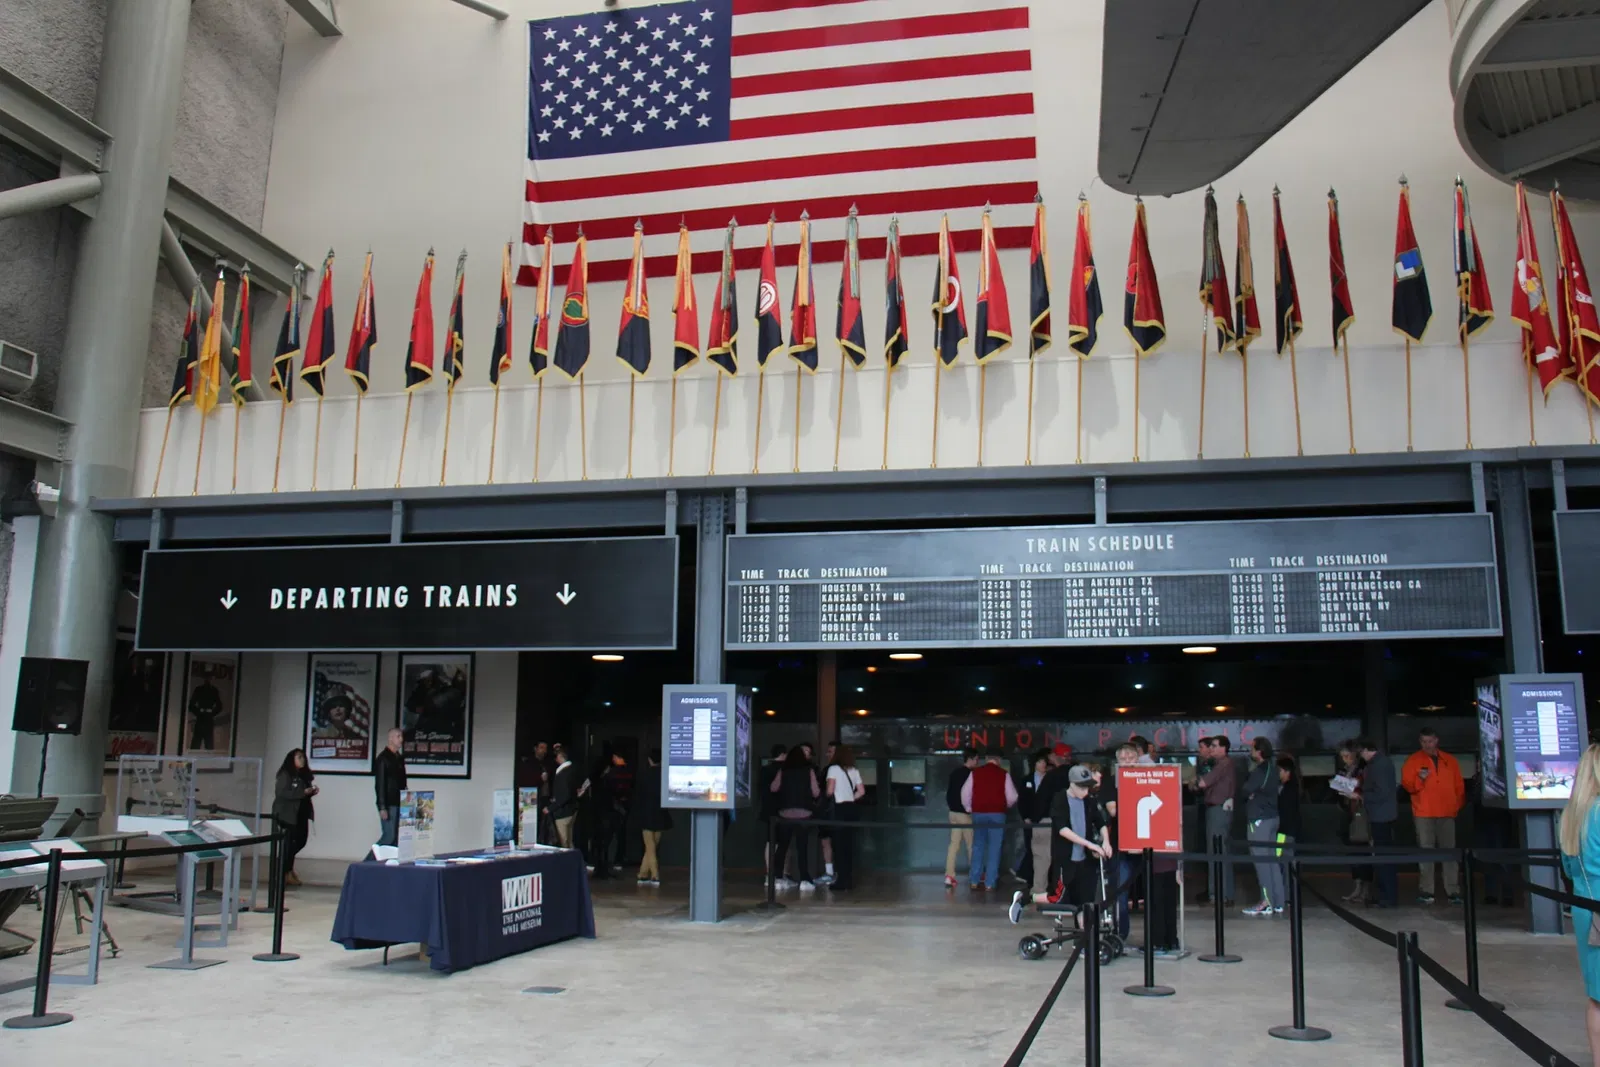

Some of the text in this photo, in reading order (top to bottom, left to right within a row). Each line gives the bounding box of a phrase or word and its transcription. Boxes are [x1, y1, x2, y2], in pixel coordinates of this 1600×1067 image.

[1026, 534, 1174, 553] TRAIN SCHEDULE
[1229, 554, 1387, 567] TIME TRACK DESTINATION
[980, 561, 1134, 573] TIME TRACK DESTINATION
[741, 567, 887, 579] TIME TRACK DESTINATION
[1232, 571, 1381, 583] 01:40 03 PHOENIX AZ
[982, 577, 1152, 589] 12:20 02 SAN ANTONIO TX
[1232, 580, 1421, 593] 01:55 04 SAN FRANCISCO CA
[743, 586, 770, 594] 11:05
[822, 584, 863, 592] HOUSTON
[982, 591, 1011, 599] 12:33
[1021, 590, 1032, 598] 03
[1066, 589, 1084, 597] LOS
[1091, 588, 1134, 596] ANGELES
[270, 584, 517, 609] DEPARTING TRAINS
[743, 595, 770, 603] 11:18
[779, 595, 790, 603] 02
[822, 594, 857, 602] KANSAS
[864, 593, 886, 601] CITY
[1066, 599, 1097, 607] NORTH
[1104, 598, 1140, 606] PLATTE
[1148, 597, 1159, 605] NE
[1273, 594, 1284, 602] 02
[1320, 592, 1363, 601] SEATTLE
[1371, 592, 1383, 600] WA
[743, 603, 880, 613] 11:30 03 CHICAGO IL
[983, 607, 1159, 619] 12:58 04 WASHINGTON D.C.
[1233, 602, 1389, 613] 02:24 01 NEW YORK NY
[779, 614, 790, 622] 05
[822, 613, 863, 621] ATLANTA
[870, 613, 881, 621] GA
[1321, 613, 1351, 622] MIAMI
[743, 623, 874, 632] 11:55 01 MOBILE AL
[982, 621, 1011, 629] 01:12
[1021, 620, 1032, 628] 05
[1068, 618, 1141, 627] JACKSONVILLE
[1234, 625, 1265, 634] 02:50
[1275, 625, 1286, 633] 05
[1322, 623, 1359, 632] BOSTON
[743, 634, 770, 642] 12:07
[779, 634, 790, 642] 04
[822, 633, 881, 641] CHARLESTON
[982, 631, 1011, 639] 01:27
[1022, 630, 1032, 638] 01
[1068, 629, 1110, 637] NORFOLK
[944, 728, 1063, 748] UNION
[502, 872, 542, 912] WWII
[503, 906, 542, 924] THE NATIONAL
[502, 917, 542, 935] WWII MUSEUM
